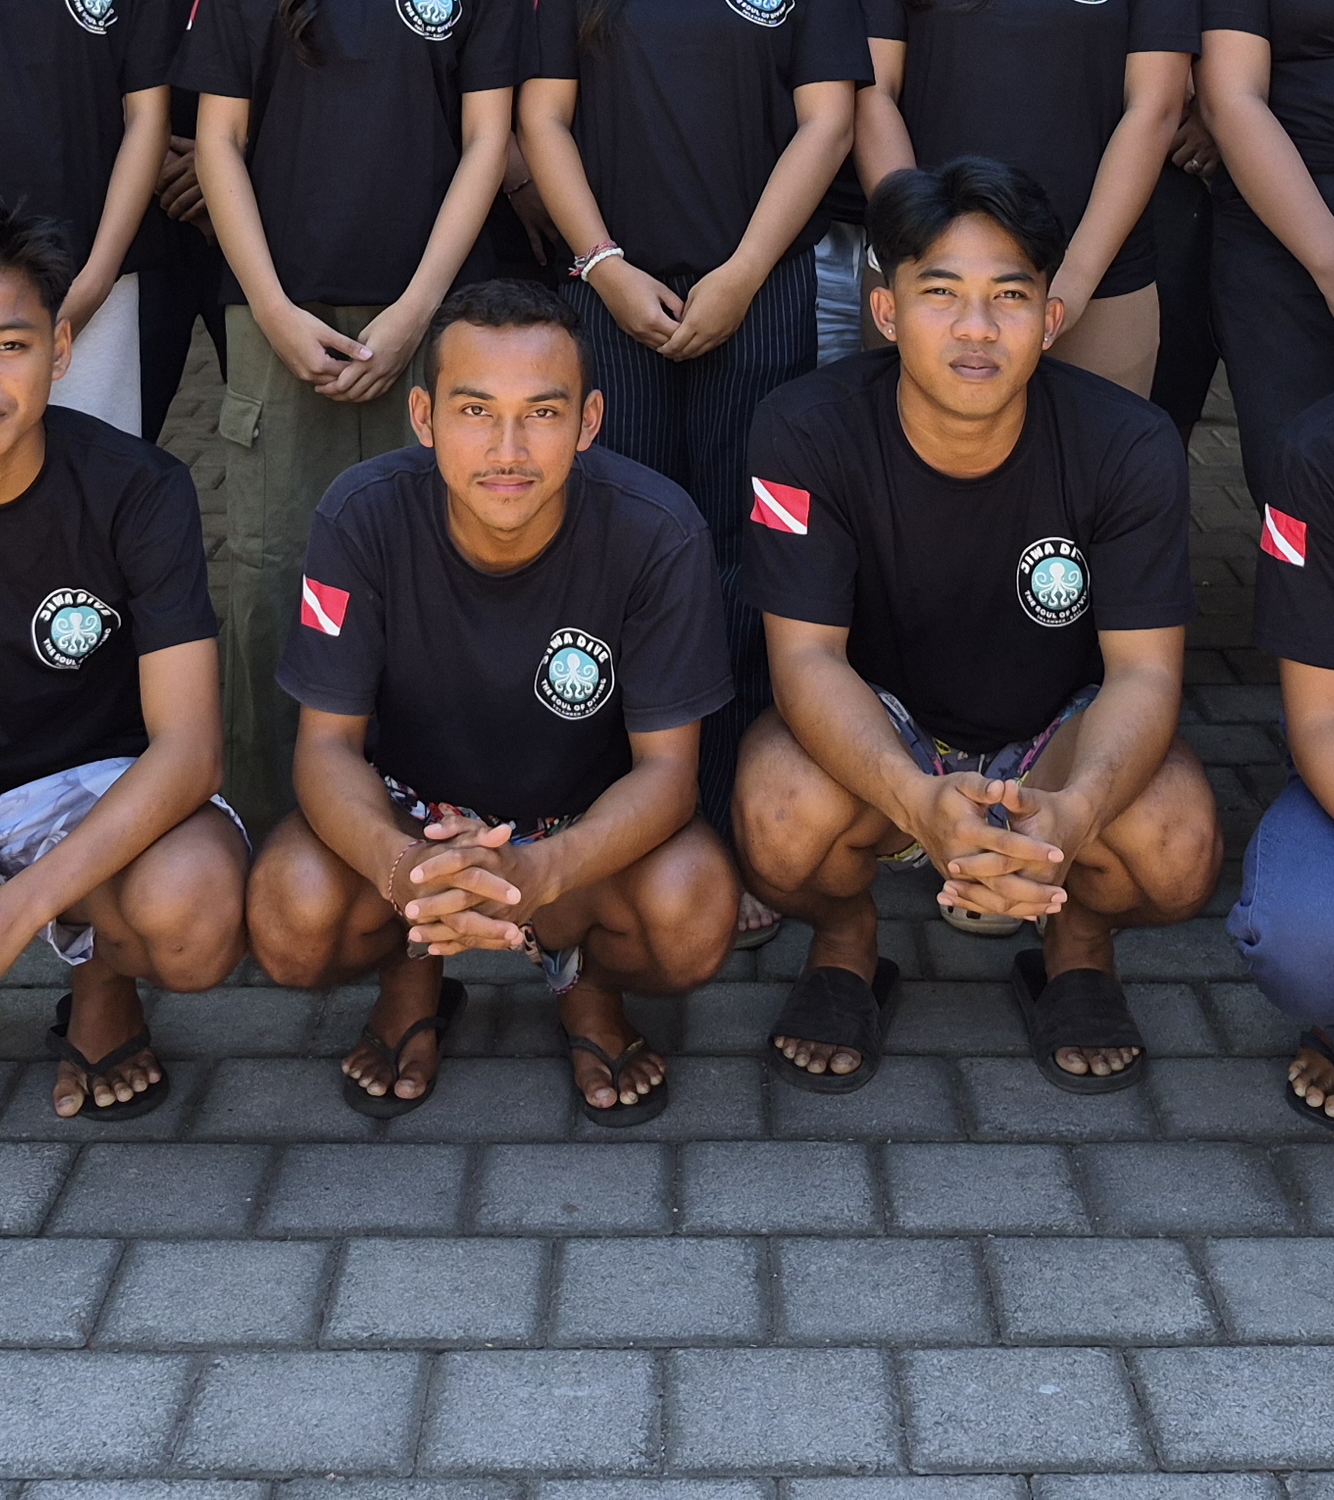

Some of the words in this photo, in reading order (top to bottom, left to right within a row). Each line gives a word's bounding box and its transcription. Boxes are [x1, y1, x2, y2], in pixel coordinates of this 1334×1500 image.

[1020, 542, 1055, 575] JIWA
[1059, 542, 1081, 562] DI
[39, 592, 74, 622] JIWA
[1035, 605, 1057, 619] SOUL
[1059, 611, 1071, 619] OF
[54, 653, 77, 666] SOUL
[576, 634, 609, 663] DIVE
[540, 678, 554, 697] THE
[550, 694, 572, 711] SOUL
[573, 704, 586, 712] OF
[587, 678, 607, 707] DIVING
